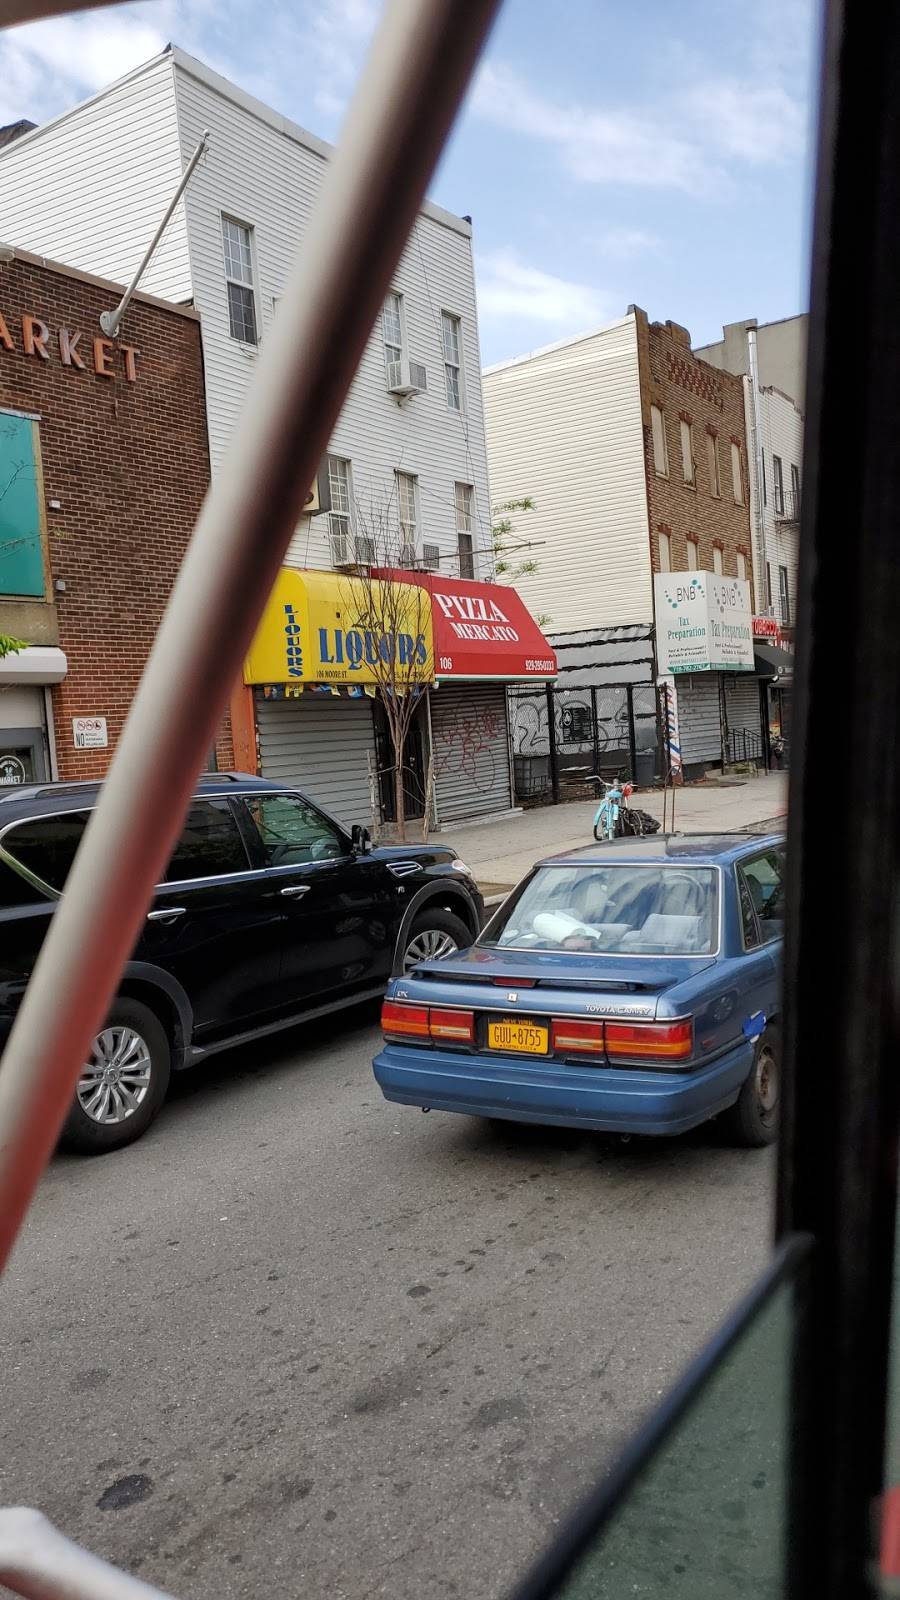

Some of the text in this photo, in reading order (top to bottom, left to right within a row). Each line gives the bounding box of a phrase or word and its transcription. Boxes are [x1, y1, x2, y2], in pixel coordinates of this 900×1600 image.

[676, 586, 696, 602] BNB
[721, 587, 736, 607] BNB
[432, 593, 509, 623] PIZZA
[678, 617, 689, 626] Tax
[450, 622, 520, 642] MERCATO
[667, 627, 706, 641] Preparation
[711, 619, 750, 642] Tax Preparation
[283, 604, 304, 678] LIQUORS
[317, 627, 428, 671] LIQUORS
[439, 657, 452, 670] 106
[324, 671, 341, 679] MOORE
[341, 671, 347, 679] ST
[76, 733, 85, 747] NO
[585, 1005, 650, 1015] TOYOTA CAMRY
